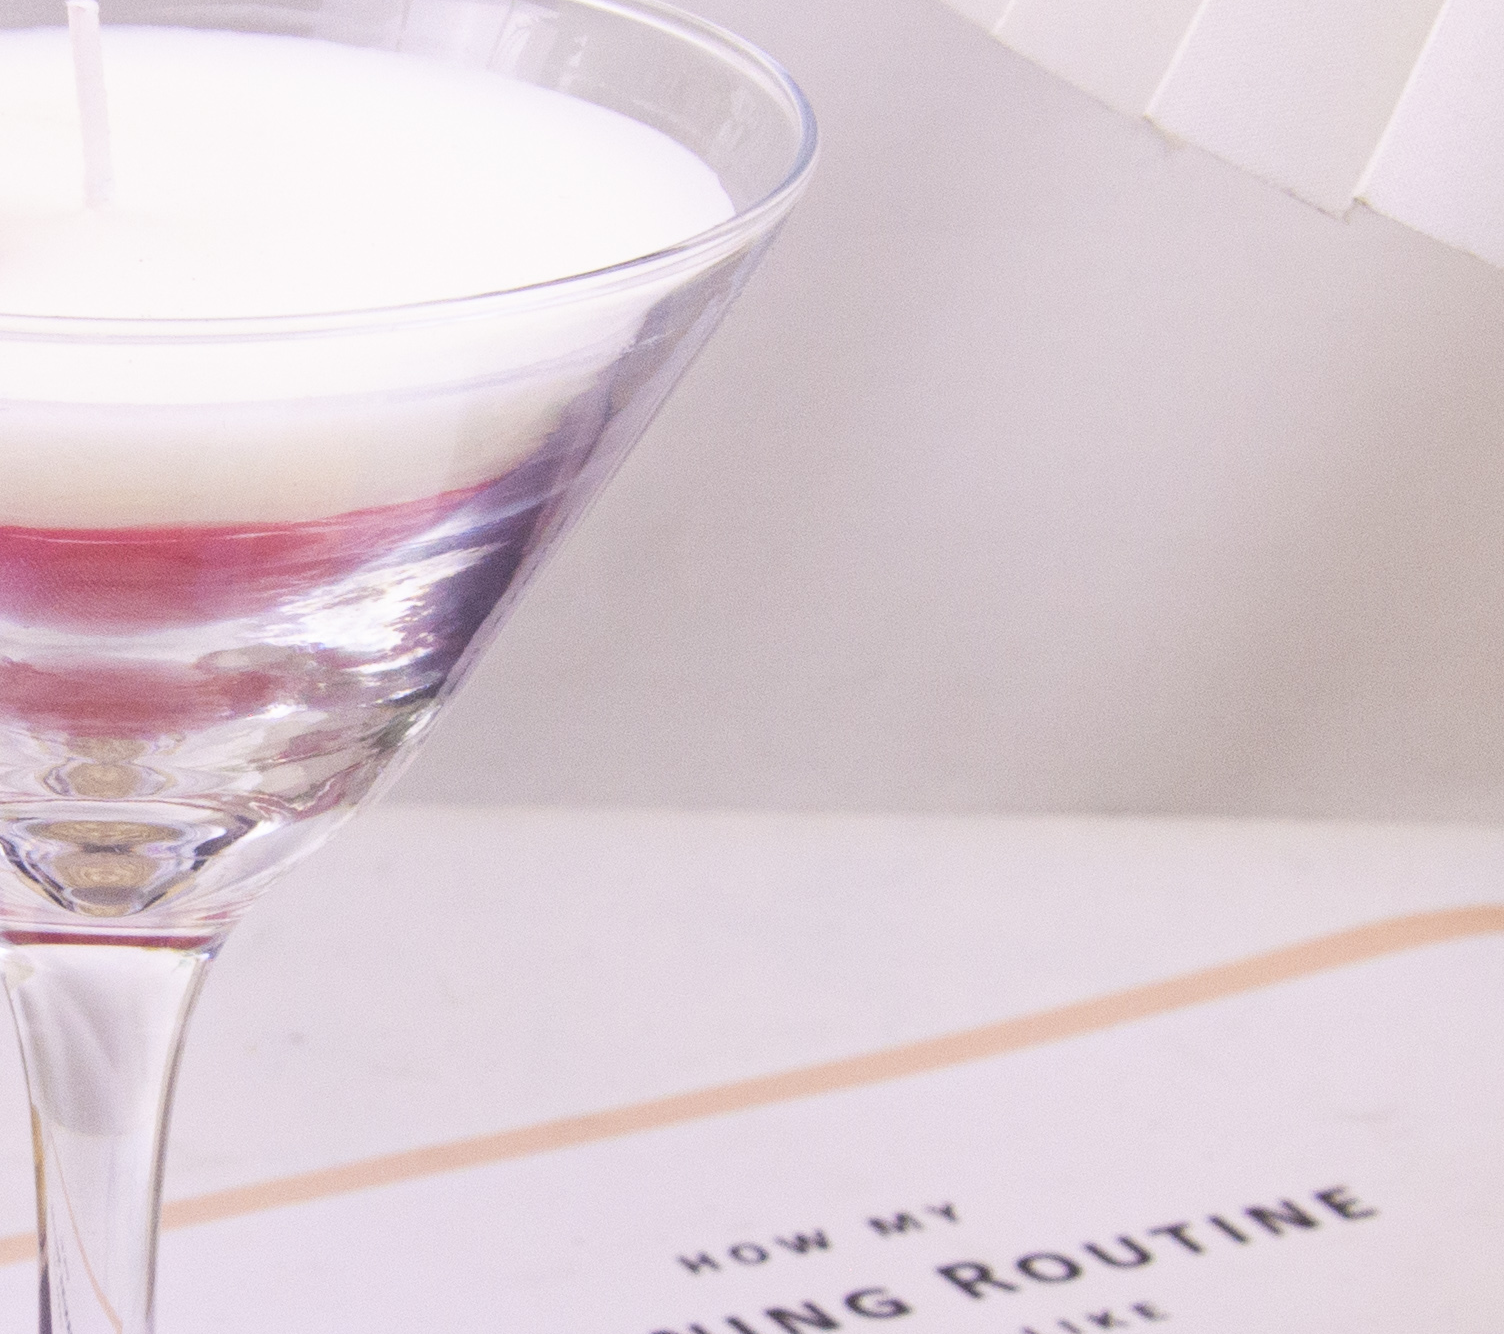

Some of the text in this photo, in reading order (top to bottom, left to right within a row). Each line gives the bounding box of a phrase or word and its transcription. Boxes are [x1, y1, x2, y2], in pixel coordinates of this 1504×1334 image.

[676, 1200, 966, 1277] HOW MY
[934, 1181, 1384, 1305] ROUTINE
